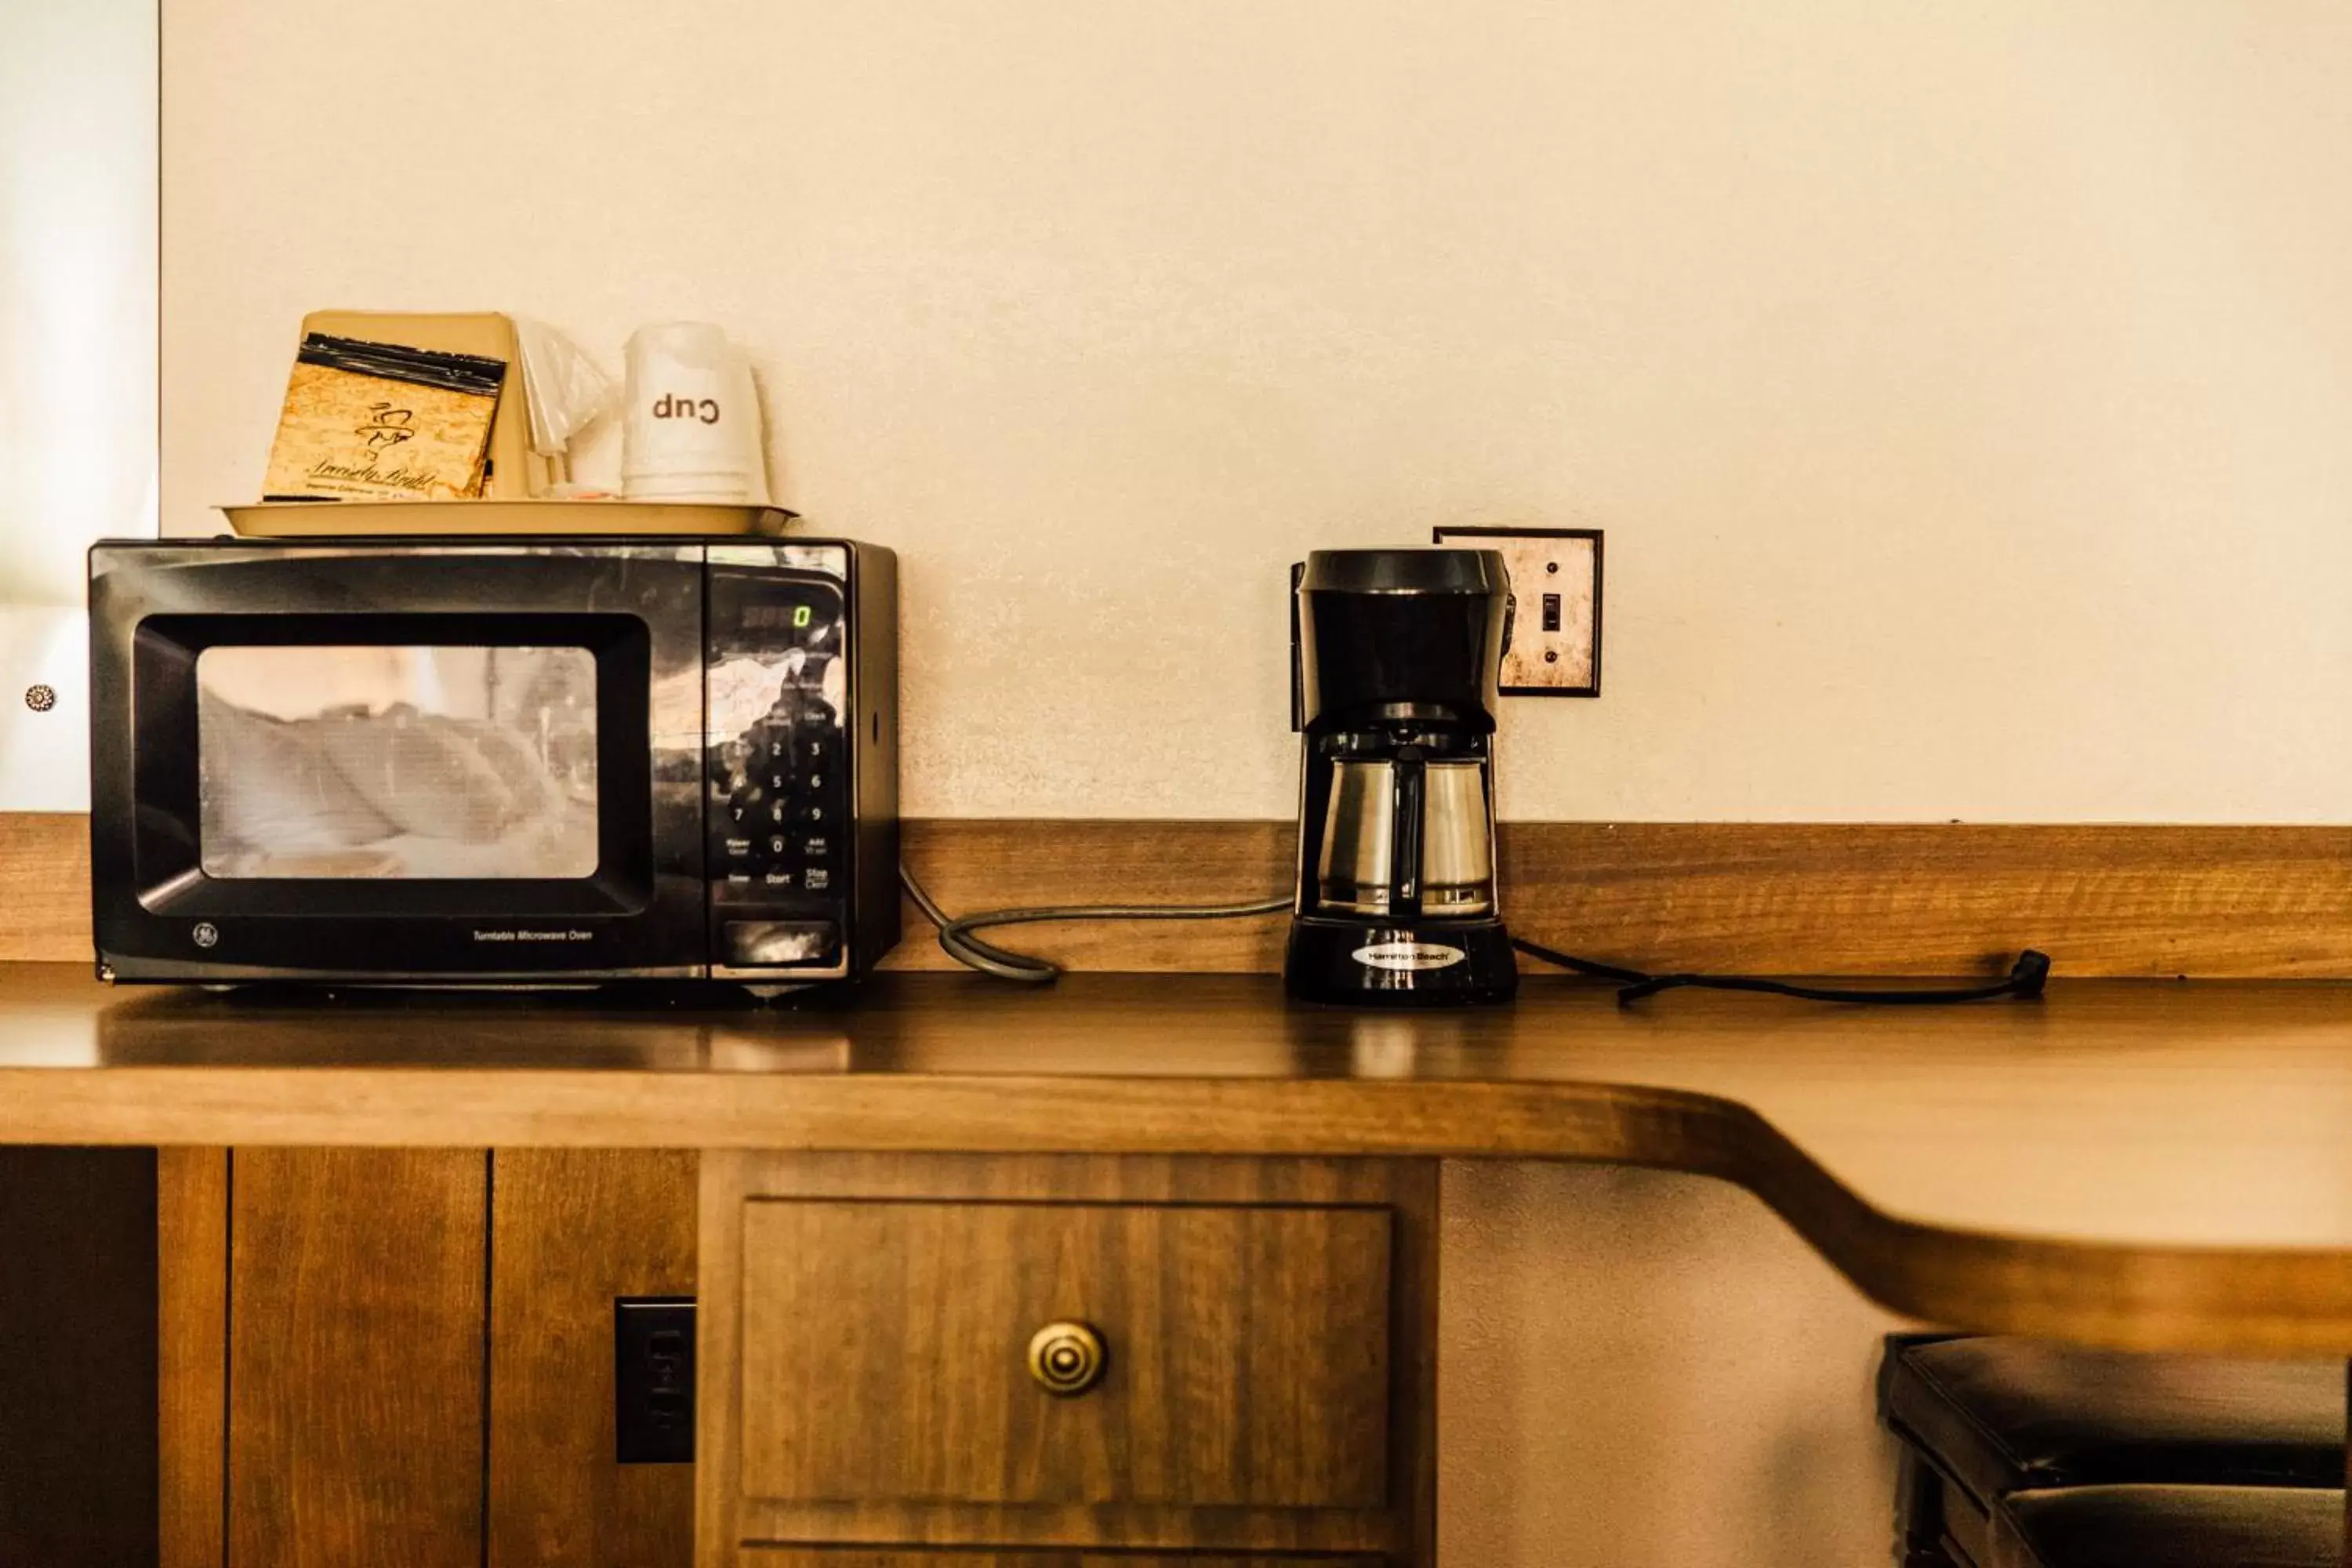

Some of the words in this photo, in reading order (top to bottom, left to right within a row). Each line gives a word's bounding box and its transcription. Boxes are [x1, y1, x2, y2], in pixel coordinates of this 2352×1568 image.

[652, 393, 720, 425] Cup
[794, 606, 811, 626] 0
[772, 742, 782, 756] 2
[811, 742, 820, 756] 3
[772, 775, 782, 788] 5
[811, 775, 821, 788] 6
[735, 808, 743, 821] 7
[811, 808, 821, 821] 9
[773, 840, 783, 853] 0
[765, 873, 790, 884] Start
[517, 930, 566, 941] Microwave
[569, 929, 593, 940] Oven
[1417, 952, 1449, 961] Beach
